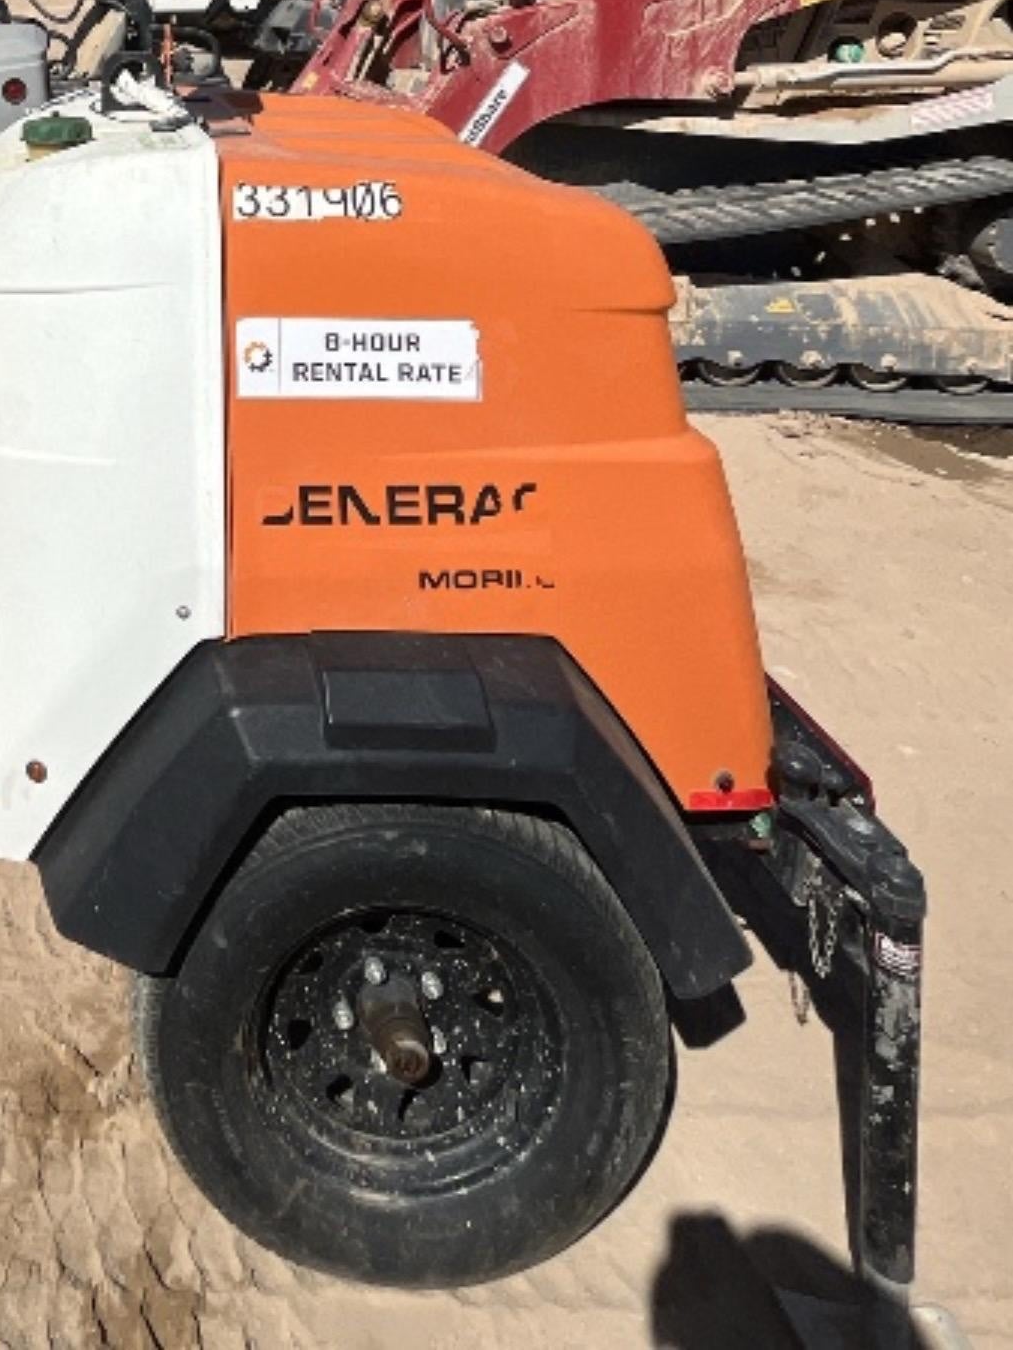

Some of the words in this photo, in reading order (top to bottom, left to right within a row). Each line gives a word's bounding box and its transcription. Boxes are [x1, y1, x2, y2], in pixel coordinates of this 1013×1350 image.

[324, 331, 421, 353] 8-HOUR
[292, 362, 388, 383] RENTAL
[397, 362, 463, 385] RATE
